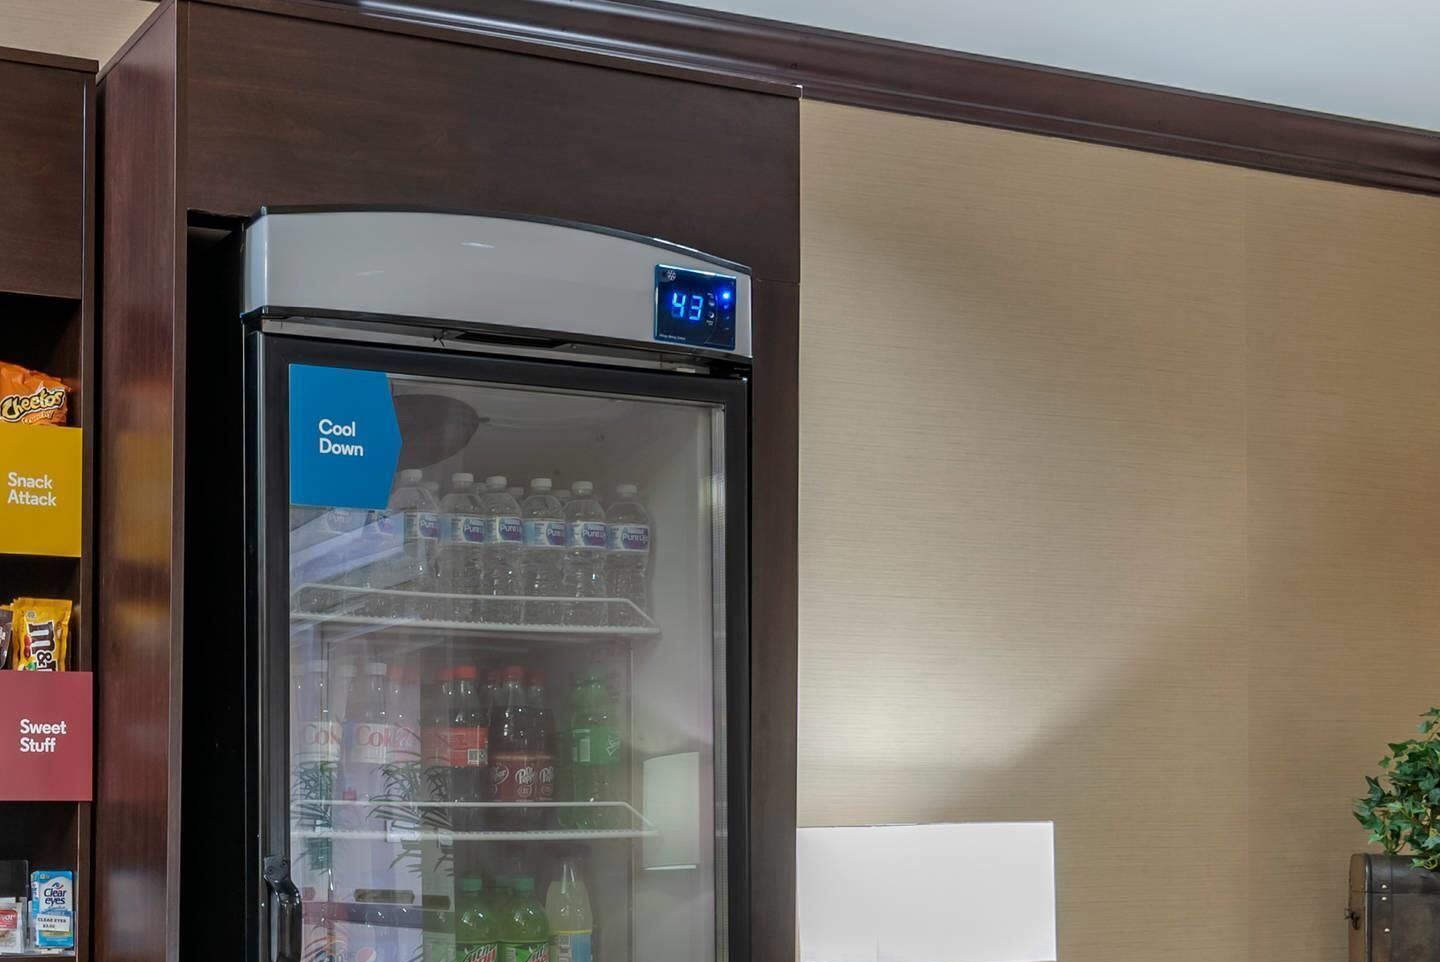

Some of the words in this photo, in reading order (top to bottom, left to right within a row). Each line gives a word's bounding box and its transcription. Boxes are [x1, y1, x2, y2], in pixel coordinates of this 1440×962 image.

[671, 292, 704, 321] 43
[0, 389, 64, 419] Cheetos
[318, 418, 356, 437] Cool
[319, 437, 364, 456] Down
[8, 472, 52, 489] Snack
[8, 489, 56, 506] Attack
[20, 718, 67, 735] Sweet
[20, 737, 56, 753] Stuff
[44, 888, 67, 897] Clear
[45, 897, 65, 906] eyes
